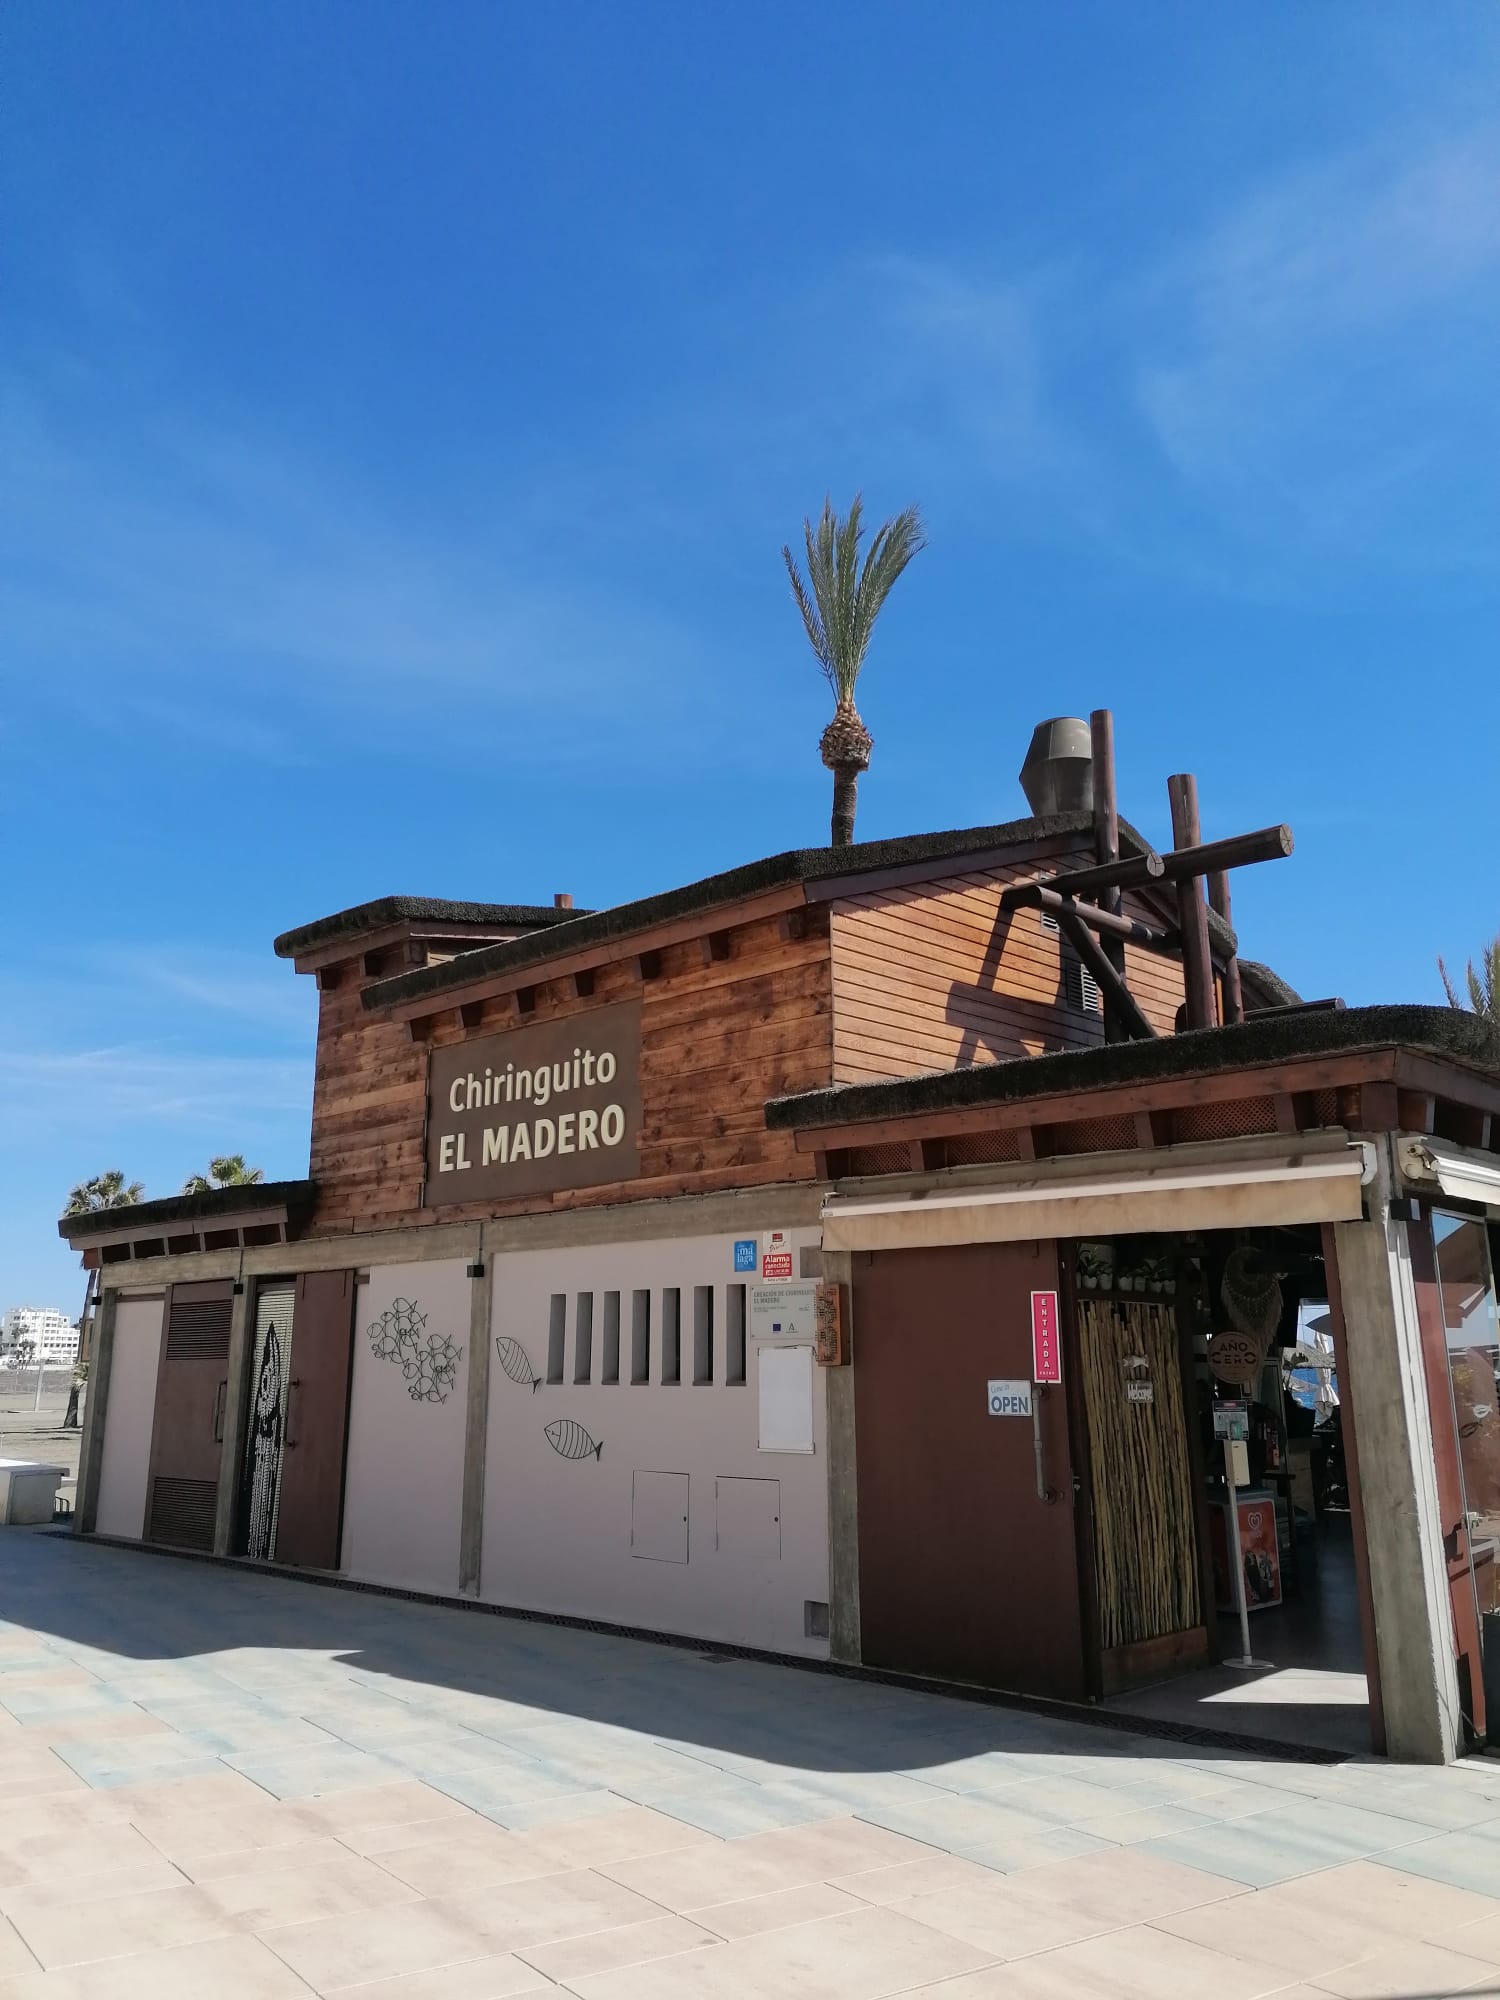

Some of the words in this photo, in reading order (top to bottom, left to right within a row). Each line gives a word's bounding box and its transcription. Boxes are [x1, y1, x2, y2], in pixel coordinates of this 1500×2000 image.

[449, 1047, 616, 1112] Chiringuito
[439, 1132, 472, 1173] EL
[482, 1104, 625, 1167] MADERO
[765, 1255, 790, 1263] Alarma
[1041, 1298, 1050, 1368] ENTRADA
[1220, 1339, 1248, 1352] AÑO
[1211, 1352, 1257, 1364] CERO
[1127, 1383, 1153, 1401] Welcome
[991, 1396, 1029, 1413] OPEN
